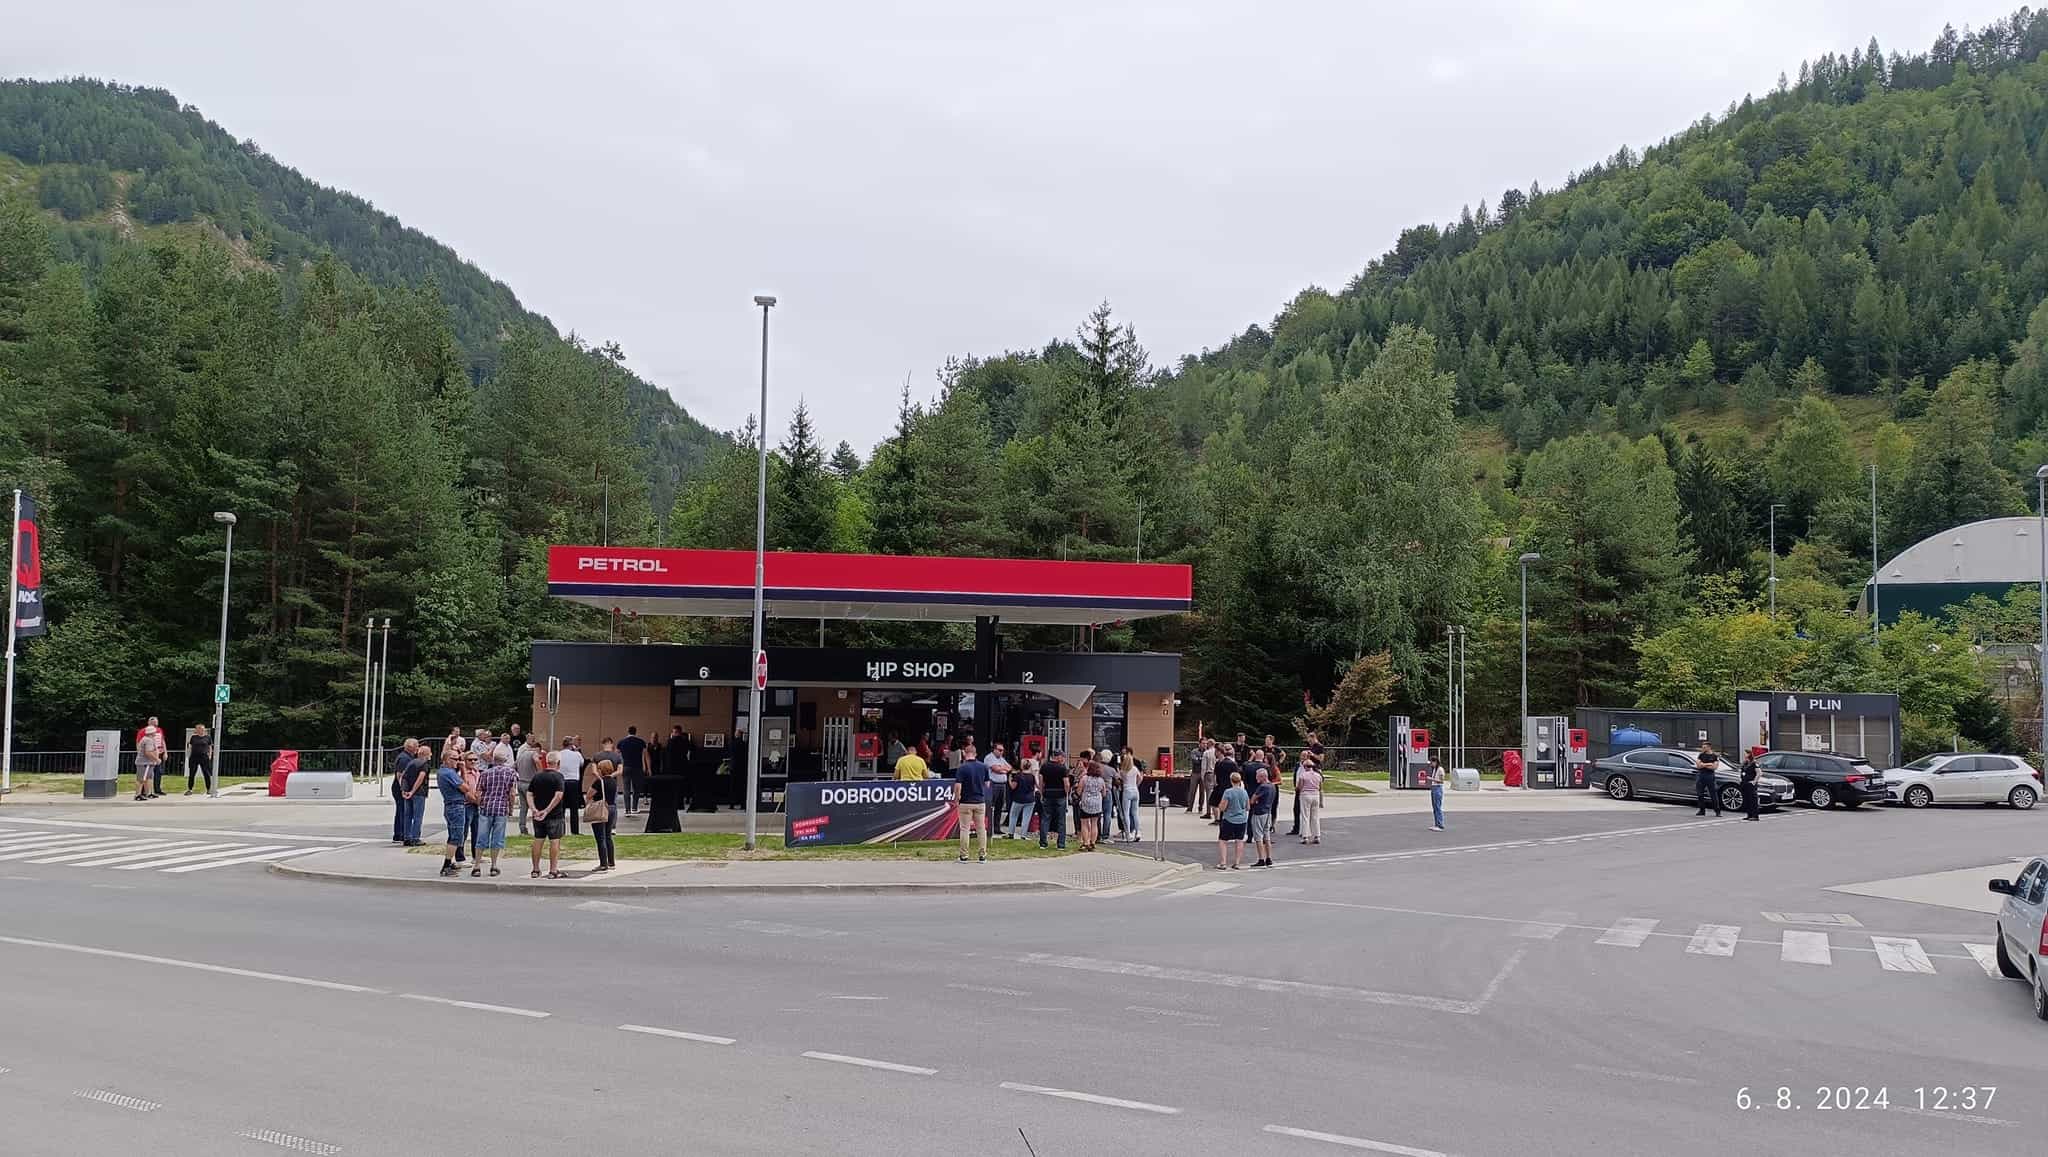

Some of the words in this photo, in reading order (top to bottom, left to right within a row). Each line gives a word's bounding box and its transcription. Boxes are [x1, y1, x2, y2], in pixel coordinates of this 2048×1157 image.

[578, 557, 668, 572] PETROL
[699, 666, 709, 679] 6
[866, 661, 898, 677] HIP
[903, 662, 955, 677] SHOP
[871, 670, 881, 681] 4
[1024, 671, 1034, 682] 2
[1809, 698, 1842, 711] PLIN
[821, 783, 931, 804] DOBRODOŠLI
